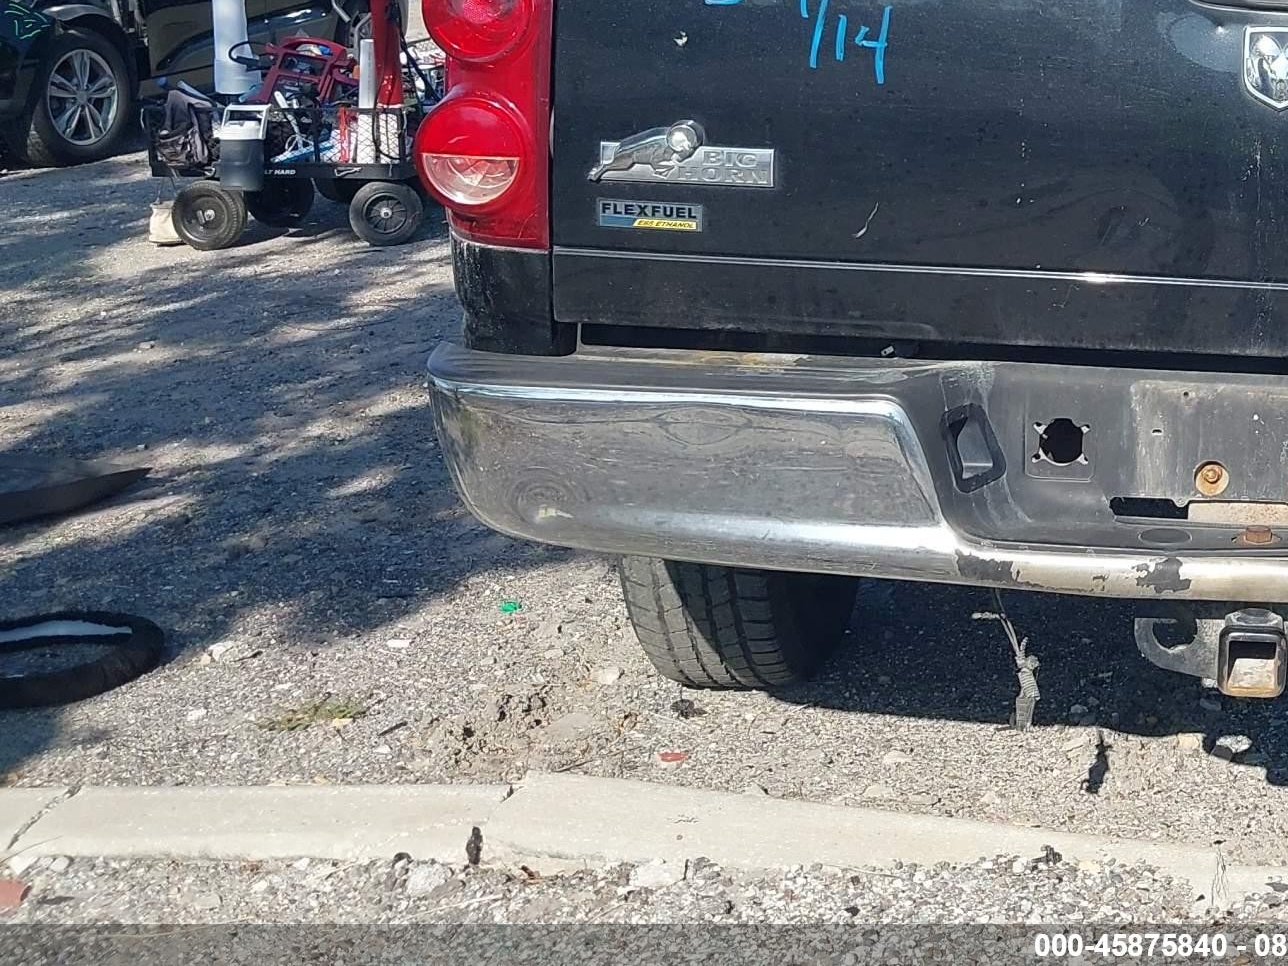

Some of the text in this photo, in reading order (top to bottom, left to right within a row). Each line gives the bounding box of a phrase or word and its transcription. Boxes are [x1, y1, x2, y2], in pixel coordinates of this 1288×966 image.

[702, 151, 759, 168] BIG
[677, 166, 768, 184] HORN
[601, 202, 698, 219] FLEXFUEL
[655, 220, 695, 229] ETHANOL
